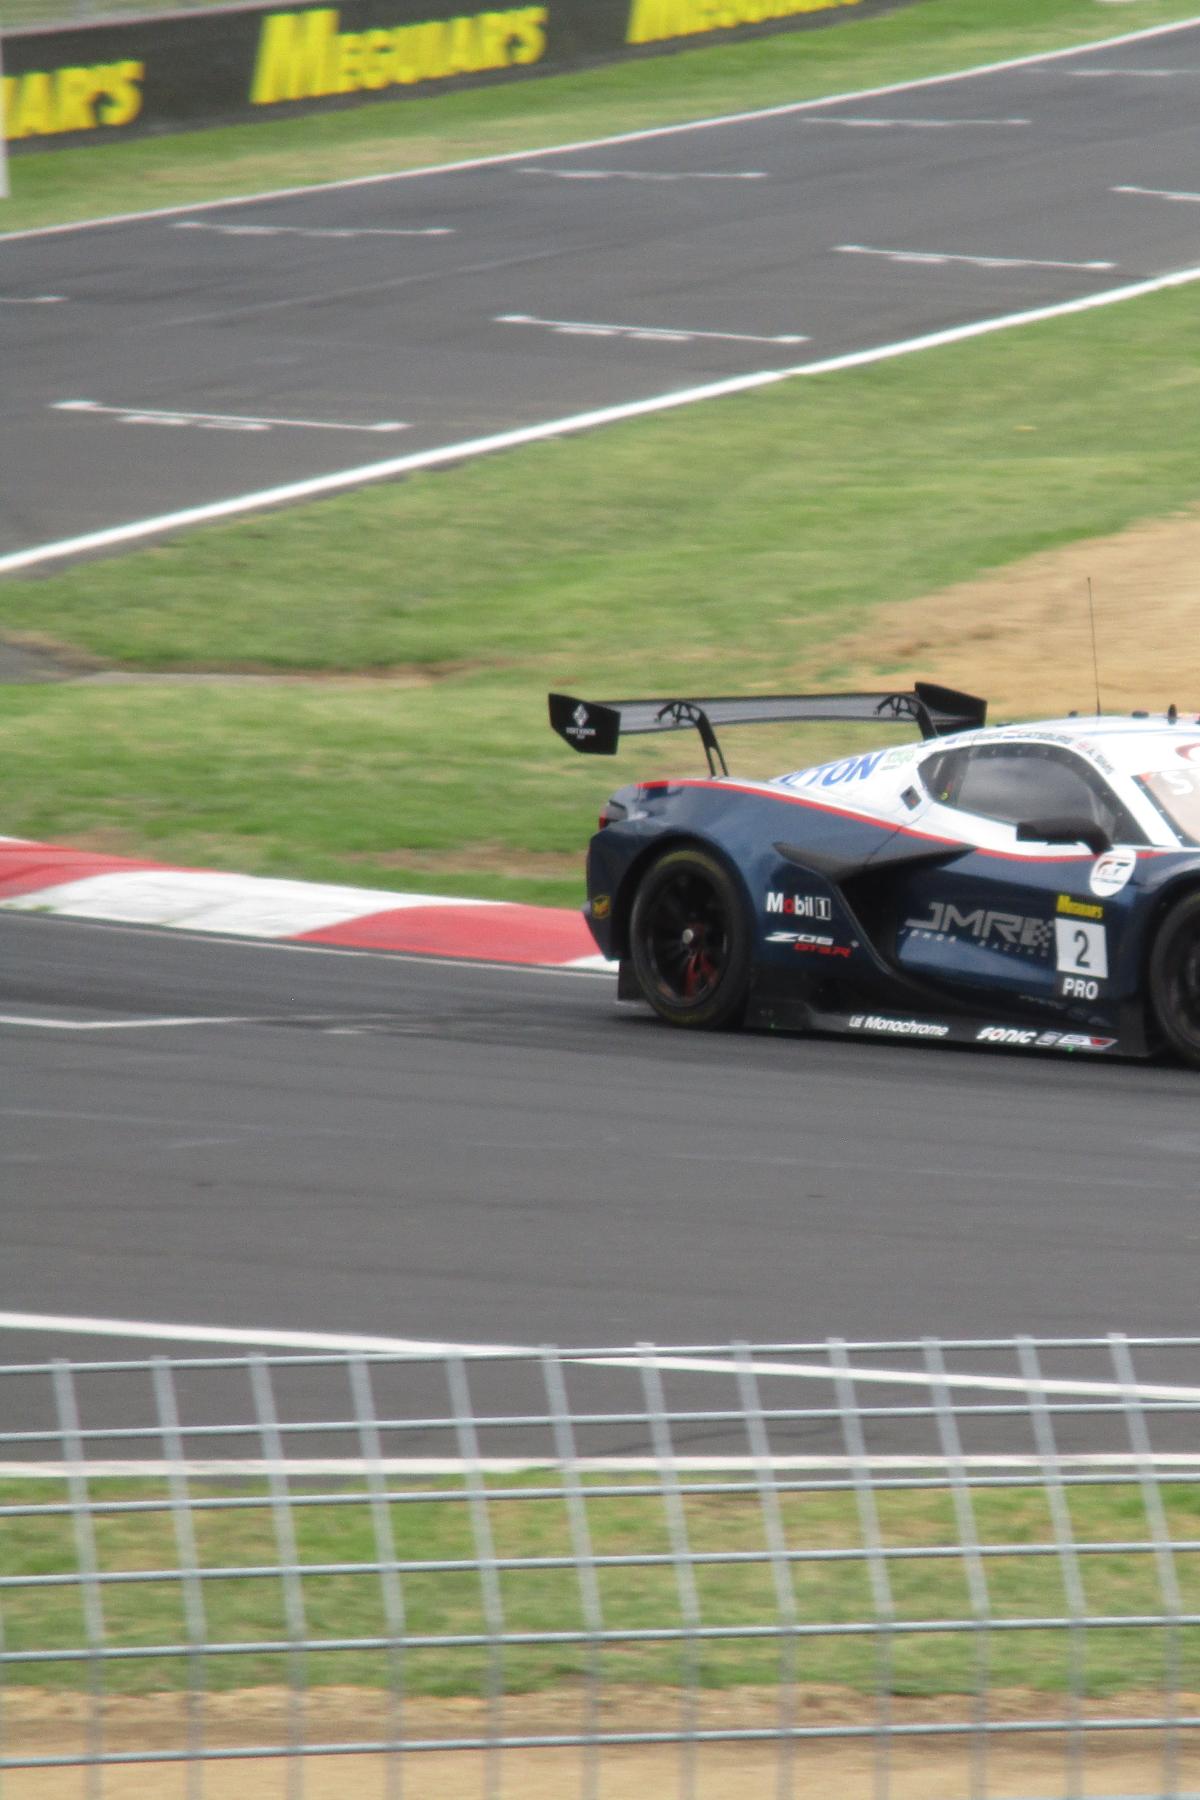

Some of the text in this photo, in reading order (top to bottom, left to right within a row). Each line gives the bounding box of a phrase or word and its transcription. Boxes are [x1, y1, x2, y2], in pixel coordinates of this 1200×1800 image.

[766, 891, 814, 917] Mobil
[1073, 929, 1091, 969] 2
[1062, 977, 1099, 1000] PRO
